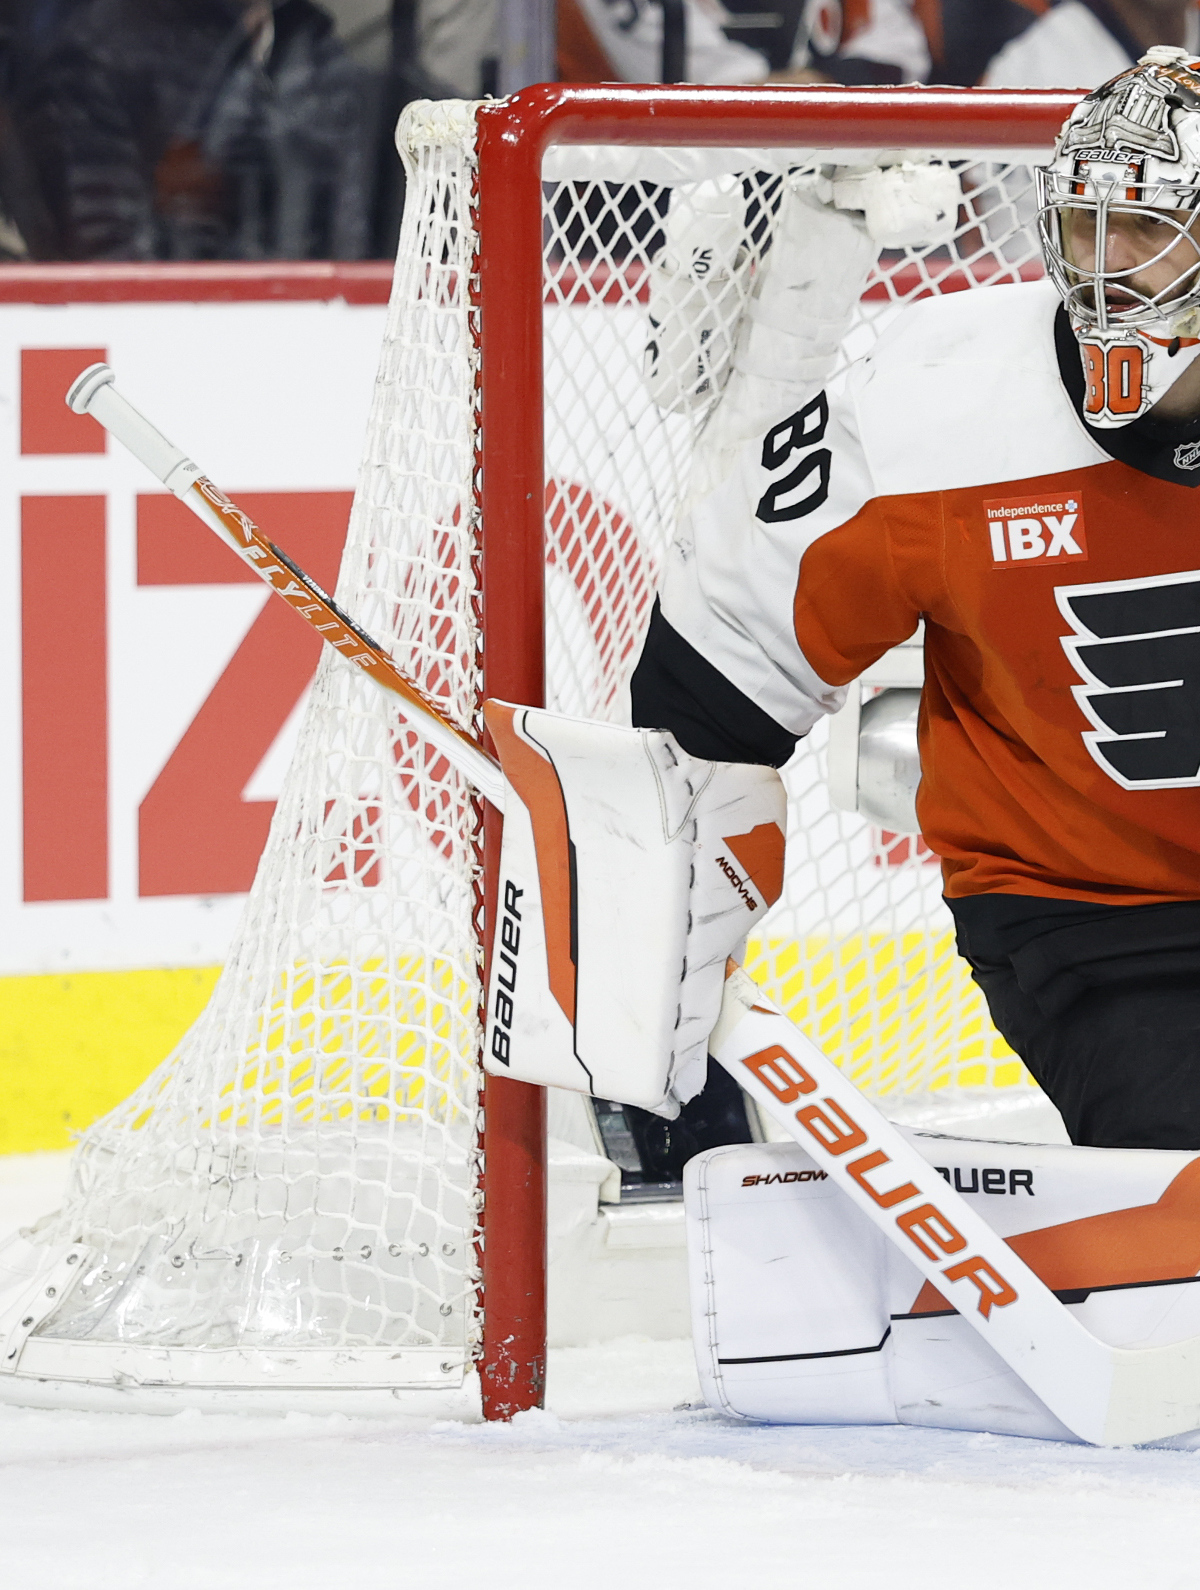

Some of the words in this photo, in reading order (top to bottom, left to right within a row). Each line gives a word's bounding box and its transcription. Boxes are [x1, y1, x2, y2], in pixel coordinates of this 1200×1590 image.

[1075, 149, 1146, 165] BAUER
[755, 389, 832, 524] 80
[987, 502, 1063, 519] Independence
[988, 513, 1084, 562] IBX
[241, 545, 377, 669] FLYLITE
[715, 856, 757, 912] SHADOW
[491, 879, 524, 1067] BAUER
[741, 1169, 830, 1188] SHADOW
[741, 1043, 1019, 1322] BAUER
[933, 1166, 1035, 1197] UER
